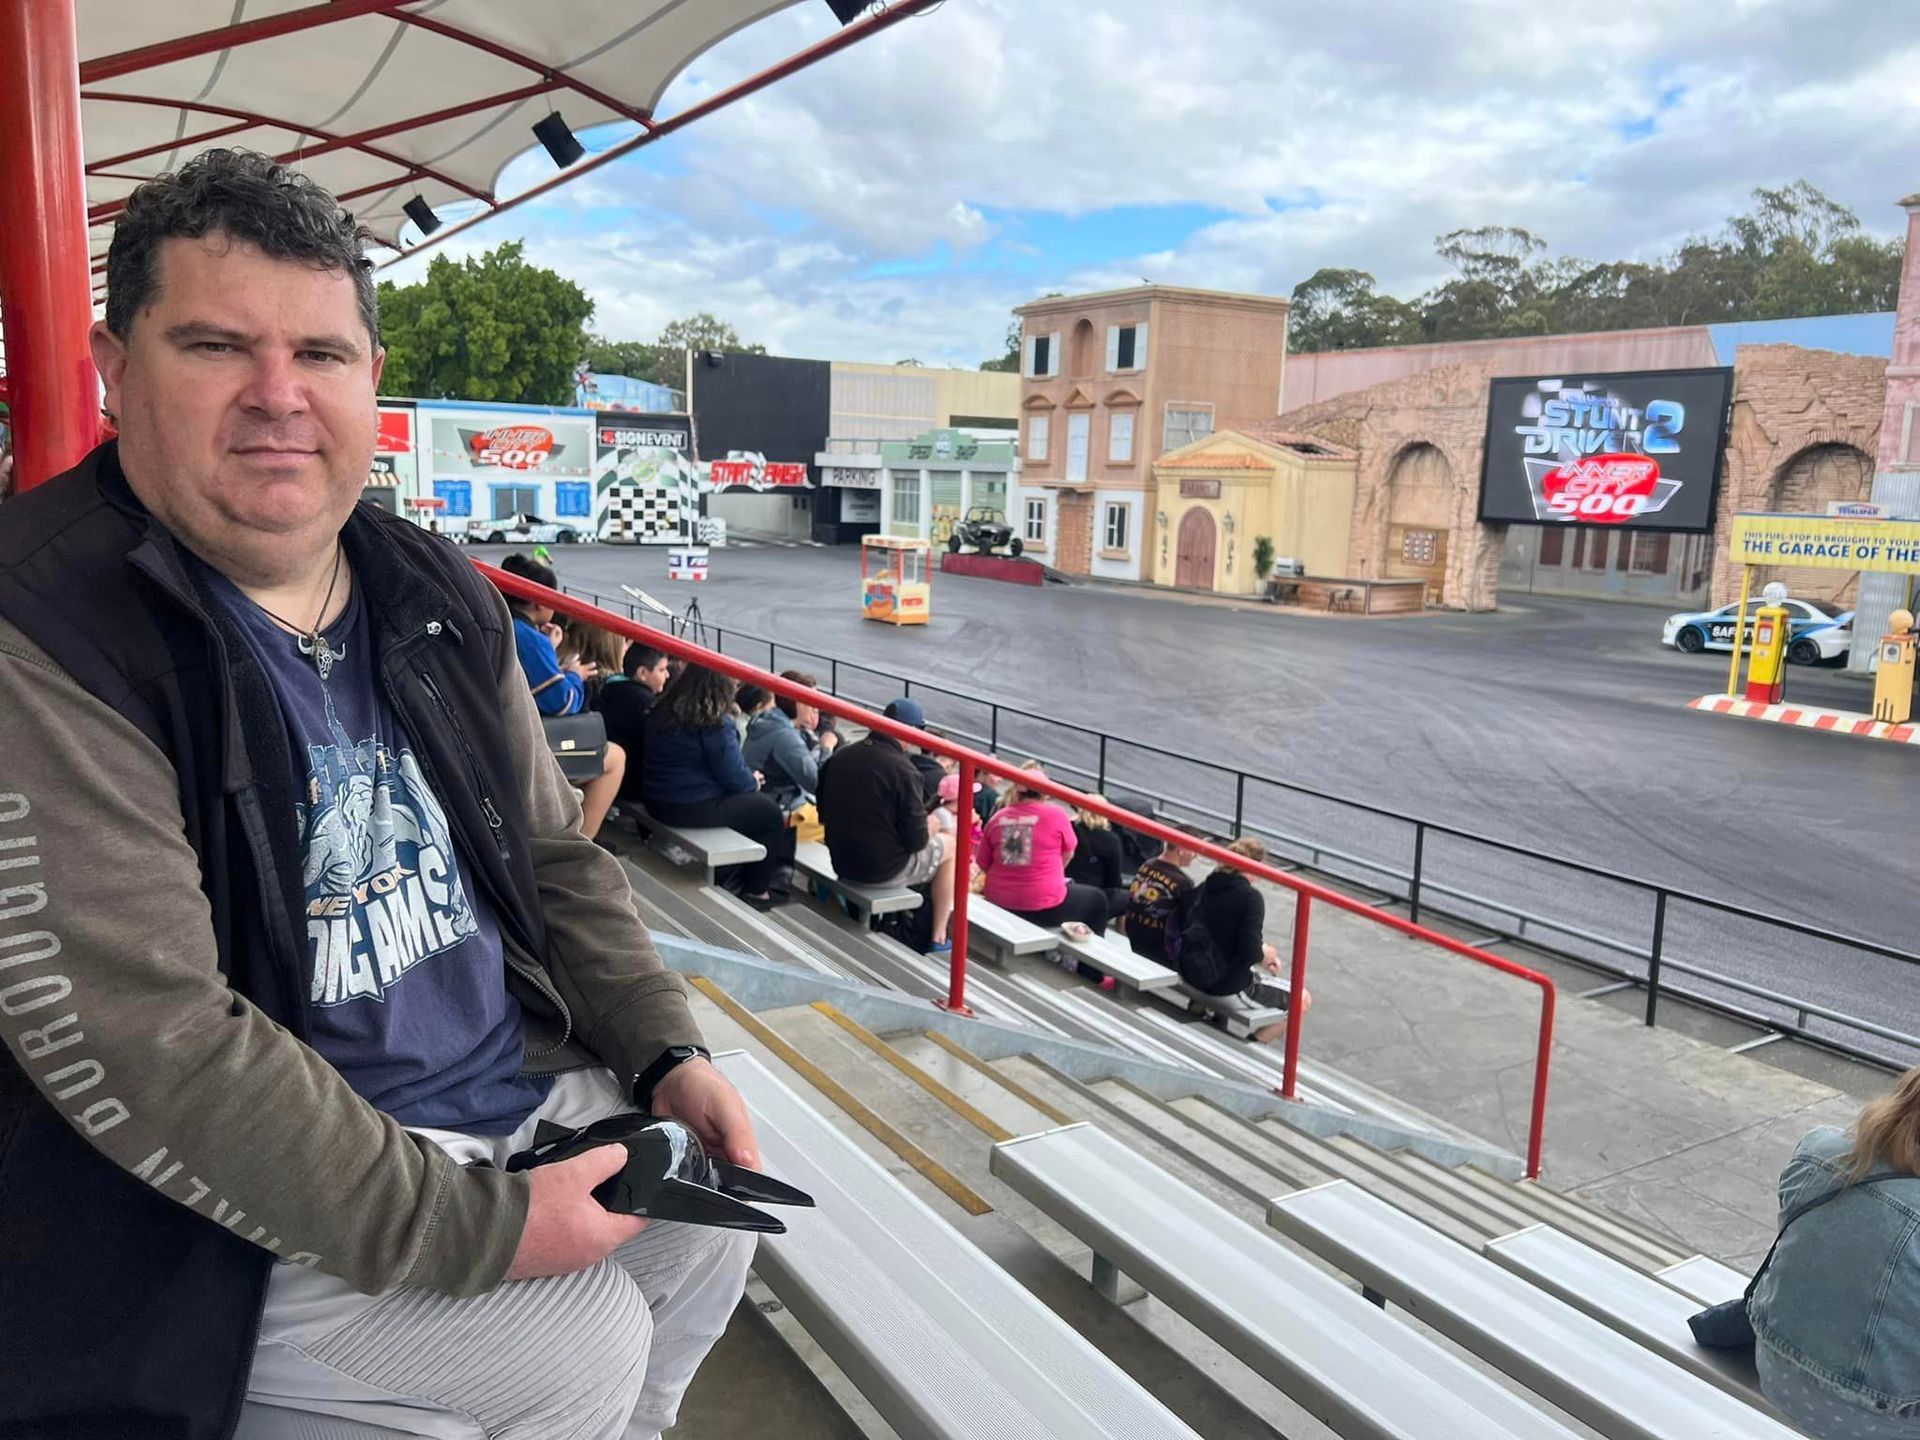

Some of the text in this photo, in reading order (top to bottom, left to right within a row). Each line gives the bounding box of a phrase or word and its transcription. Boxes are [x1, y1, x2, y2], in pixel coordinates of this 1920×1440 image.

[1544, 400, 1642, 431] STUNT
[1515, 400, 1685, 456] DRIVER 2
[480, 449, 549, 464] 500
[833, 468, 876, 486] PARKING
[1547, 492, 1646, 515] 500
[1744, 531, 1763, 540] THIS
[1814, 534, 1822, 542] IS
[1825, 535, 1871, 545] BROUGHT
[1874, 537, 1886, 545] TO
[1890, 538, 1911, 547] YOU
[1743, 540, 1920, 562] THE GARAGE OF THE
[1712, 625, 1754, 639] SAFTY
